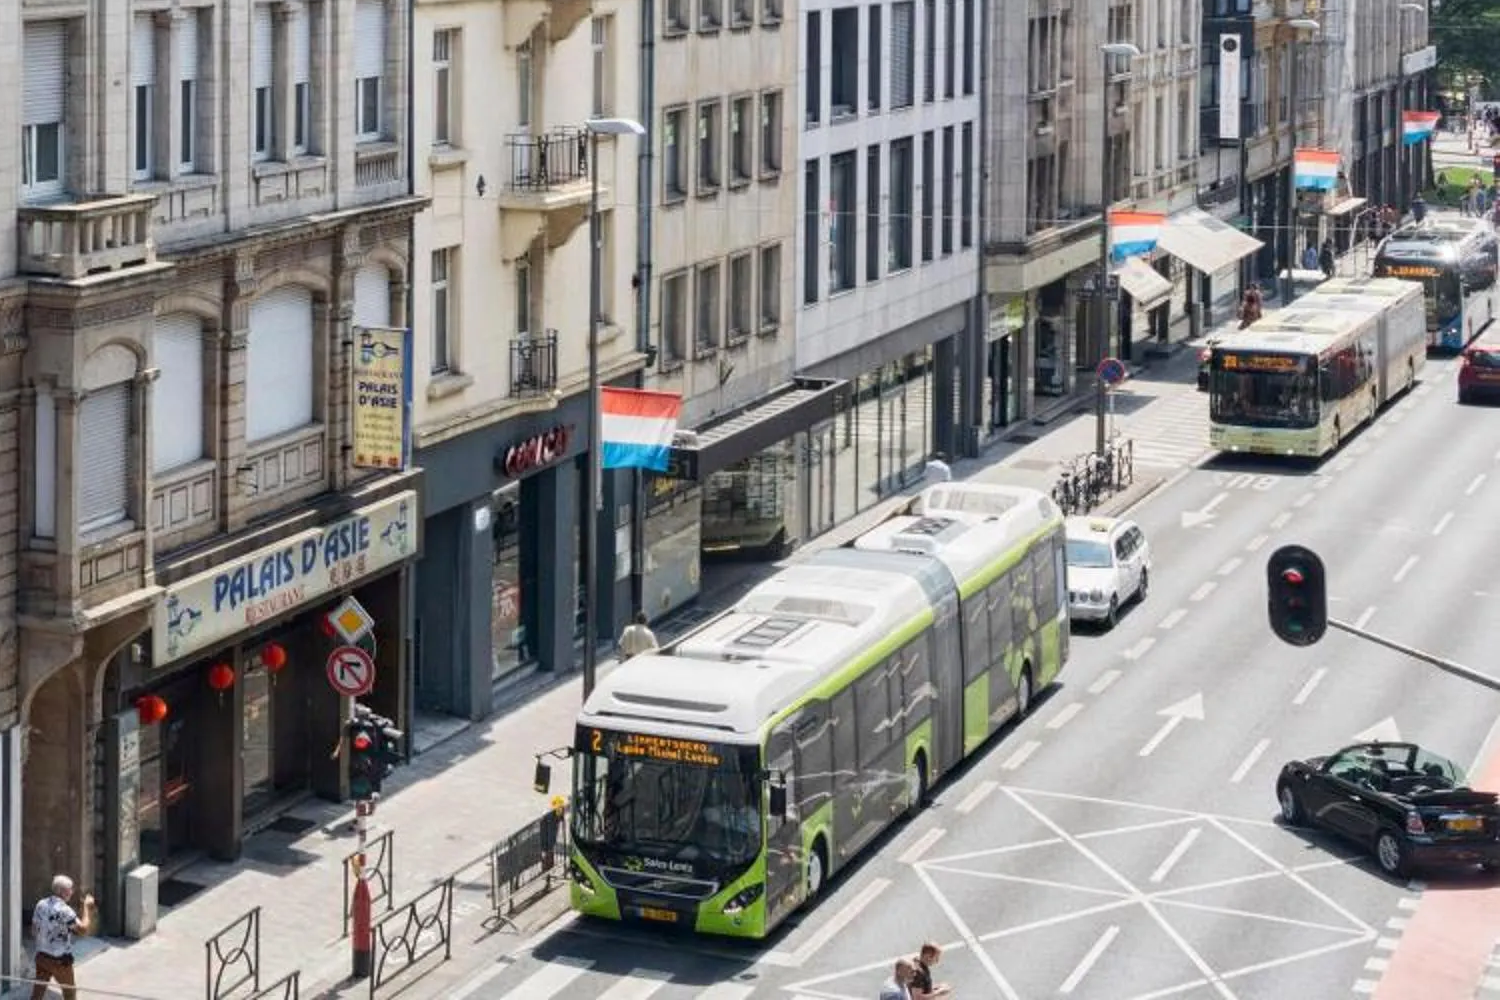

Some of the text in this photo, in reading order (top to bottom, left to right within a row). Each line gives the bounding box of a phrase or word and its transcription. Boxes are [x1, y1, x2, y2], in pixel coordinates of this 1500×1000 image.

[358, 381, 398, 394] PALAIS
[214, 548, 295, 613] PALAIS
[301, 516, 371, 575] D'ASIE
[591, 728, 602, 751] 2
